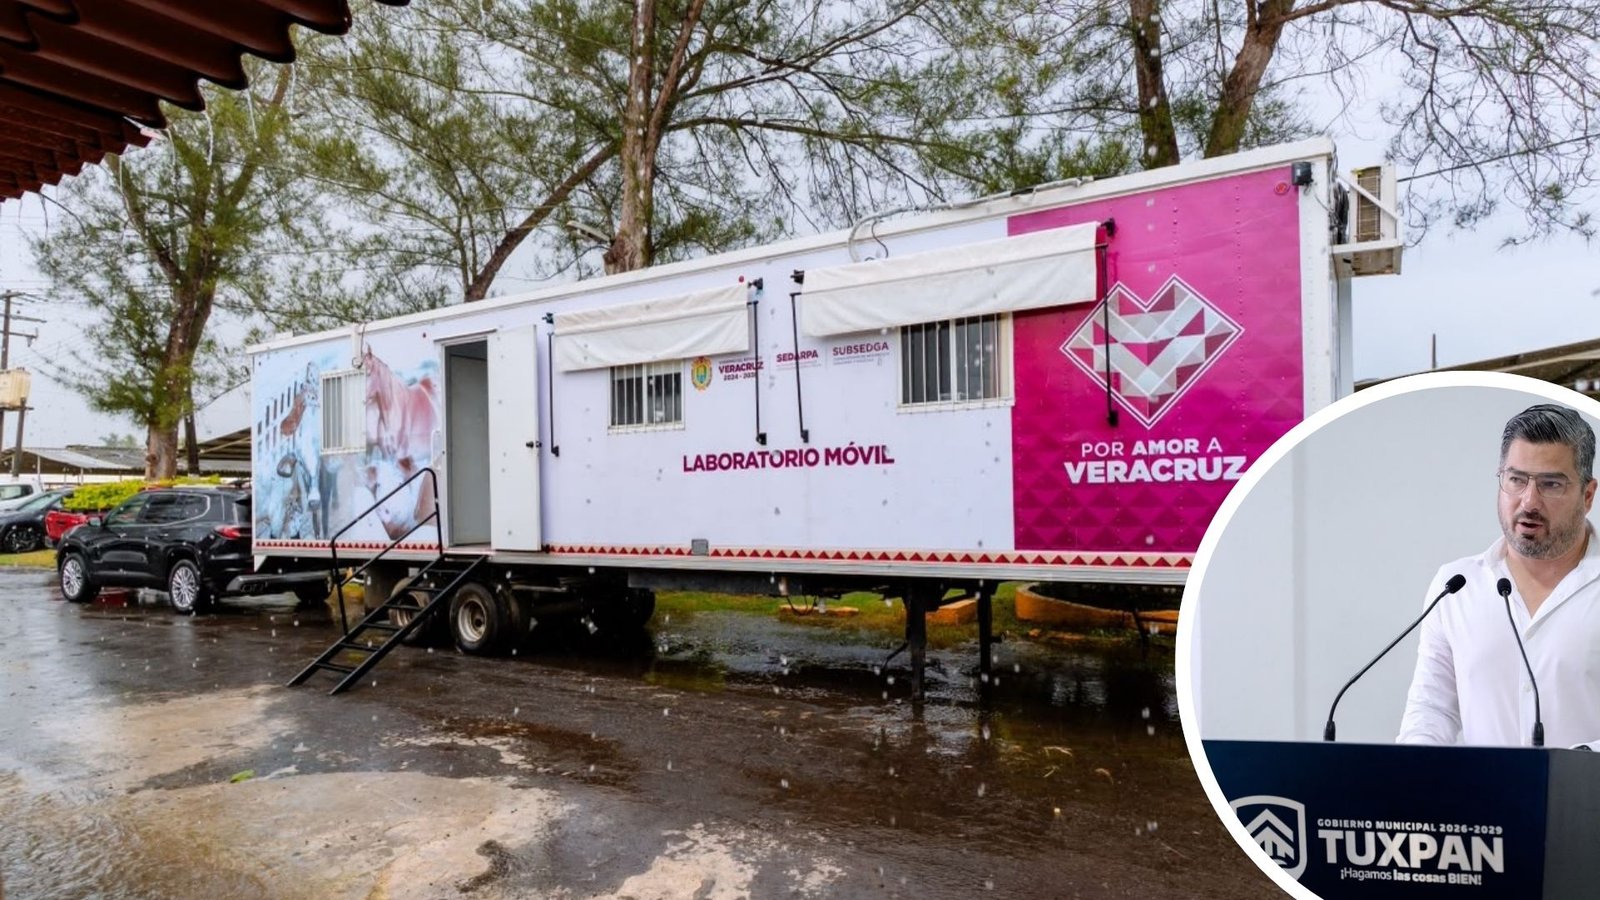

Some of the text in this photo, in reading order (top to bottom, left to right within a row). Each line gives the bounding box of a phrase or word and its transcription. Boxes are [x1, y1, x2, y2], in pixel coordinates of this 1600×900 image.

[776, 349, 819, 363] SEDARPA
[832, 341, 889, 356] SUBSEDGA
[718, 361, 764, 374] VERACRUZ
[1081, 437, 1223, 457] POR AMOR A
[683, 442, 895, 472] LABORATORIO MÓVIL
[1063, 456, 1247, 484] VERACRUZ
[1317, 818, 1503, 835] GOBIERNO MUNICIPAL 2026-2029
[1318, 829, 1504, 873] TUXPAN
[1340, 867, 1482, 886] ¡Hagamos las cosas BIEN!
